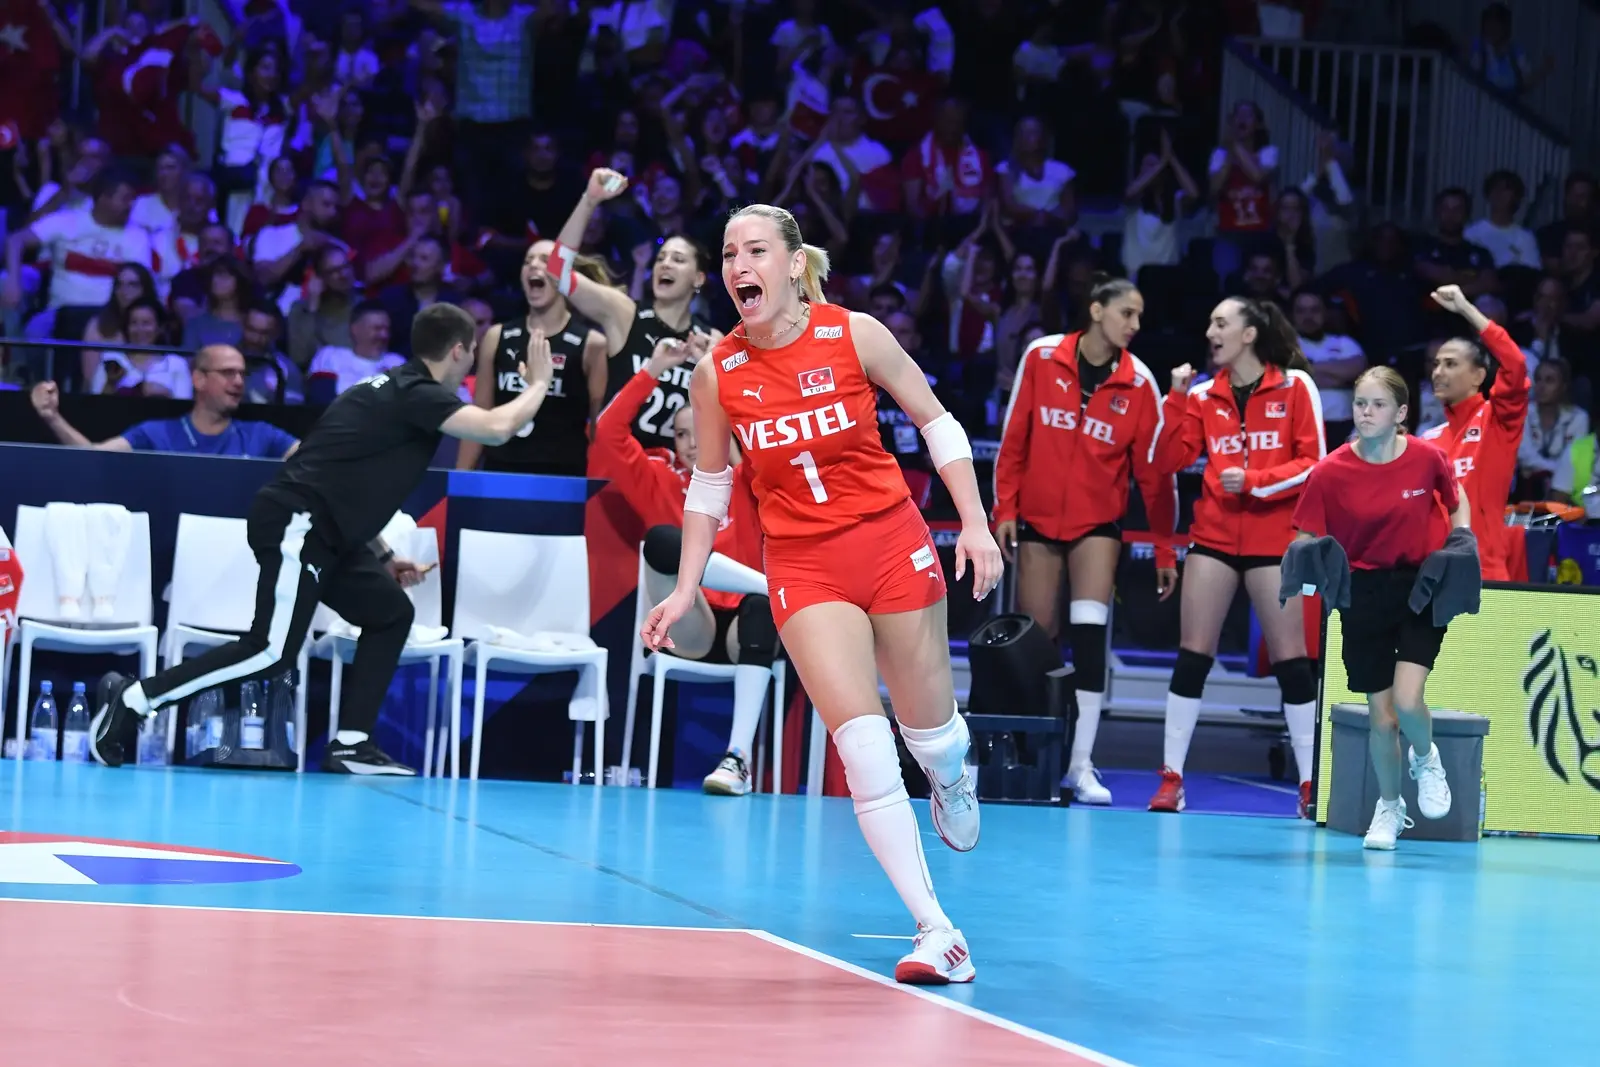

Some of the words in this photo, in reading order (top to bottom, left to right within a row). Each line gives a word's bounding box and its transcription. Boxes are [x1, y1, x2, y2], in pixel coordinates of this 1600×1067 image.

[815, 328, 842, 338] Orkid
[724, 351, 748, 371] Orkid
[809, 386, 828, 395] TUR
[735, 401, 857, 451] VESTEL
[789, 450, 829, 504] 1
[777, 587, 788, 610] 1
